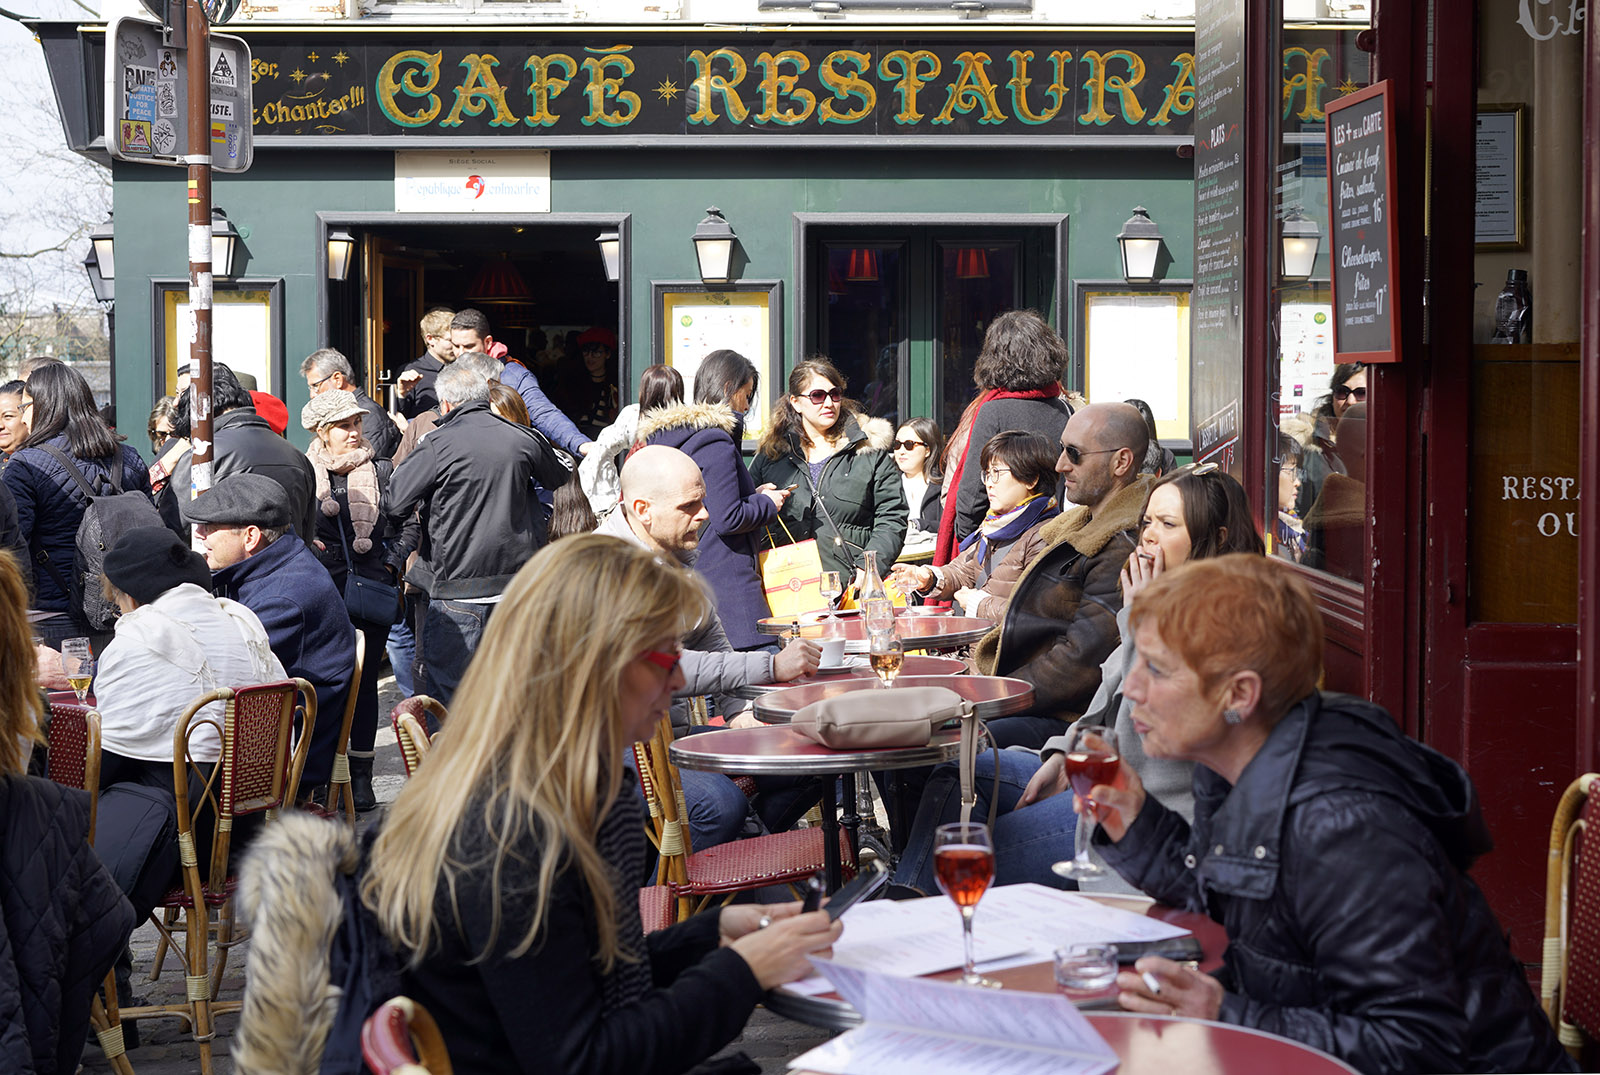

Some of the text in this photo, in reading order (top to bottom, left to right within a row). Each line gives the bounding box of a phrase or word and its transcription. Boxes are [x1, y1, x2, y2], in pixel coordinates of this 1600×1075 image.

[130, 94, 155, 102] JUSTICE
[375, 44, 642, 127] CAFÉ
[132, 108, 152, 117] PEACE
[136, 101, 149, 109] FOR
[262, 86, 365, 125] Chanter!!!
[1210, 123, 1226, 149] PLATS
[1334, 124, 1345, 146] LES
[1362, 111, 1382, 136] CARTE
